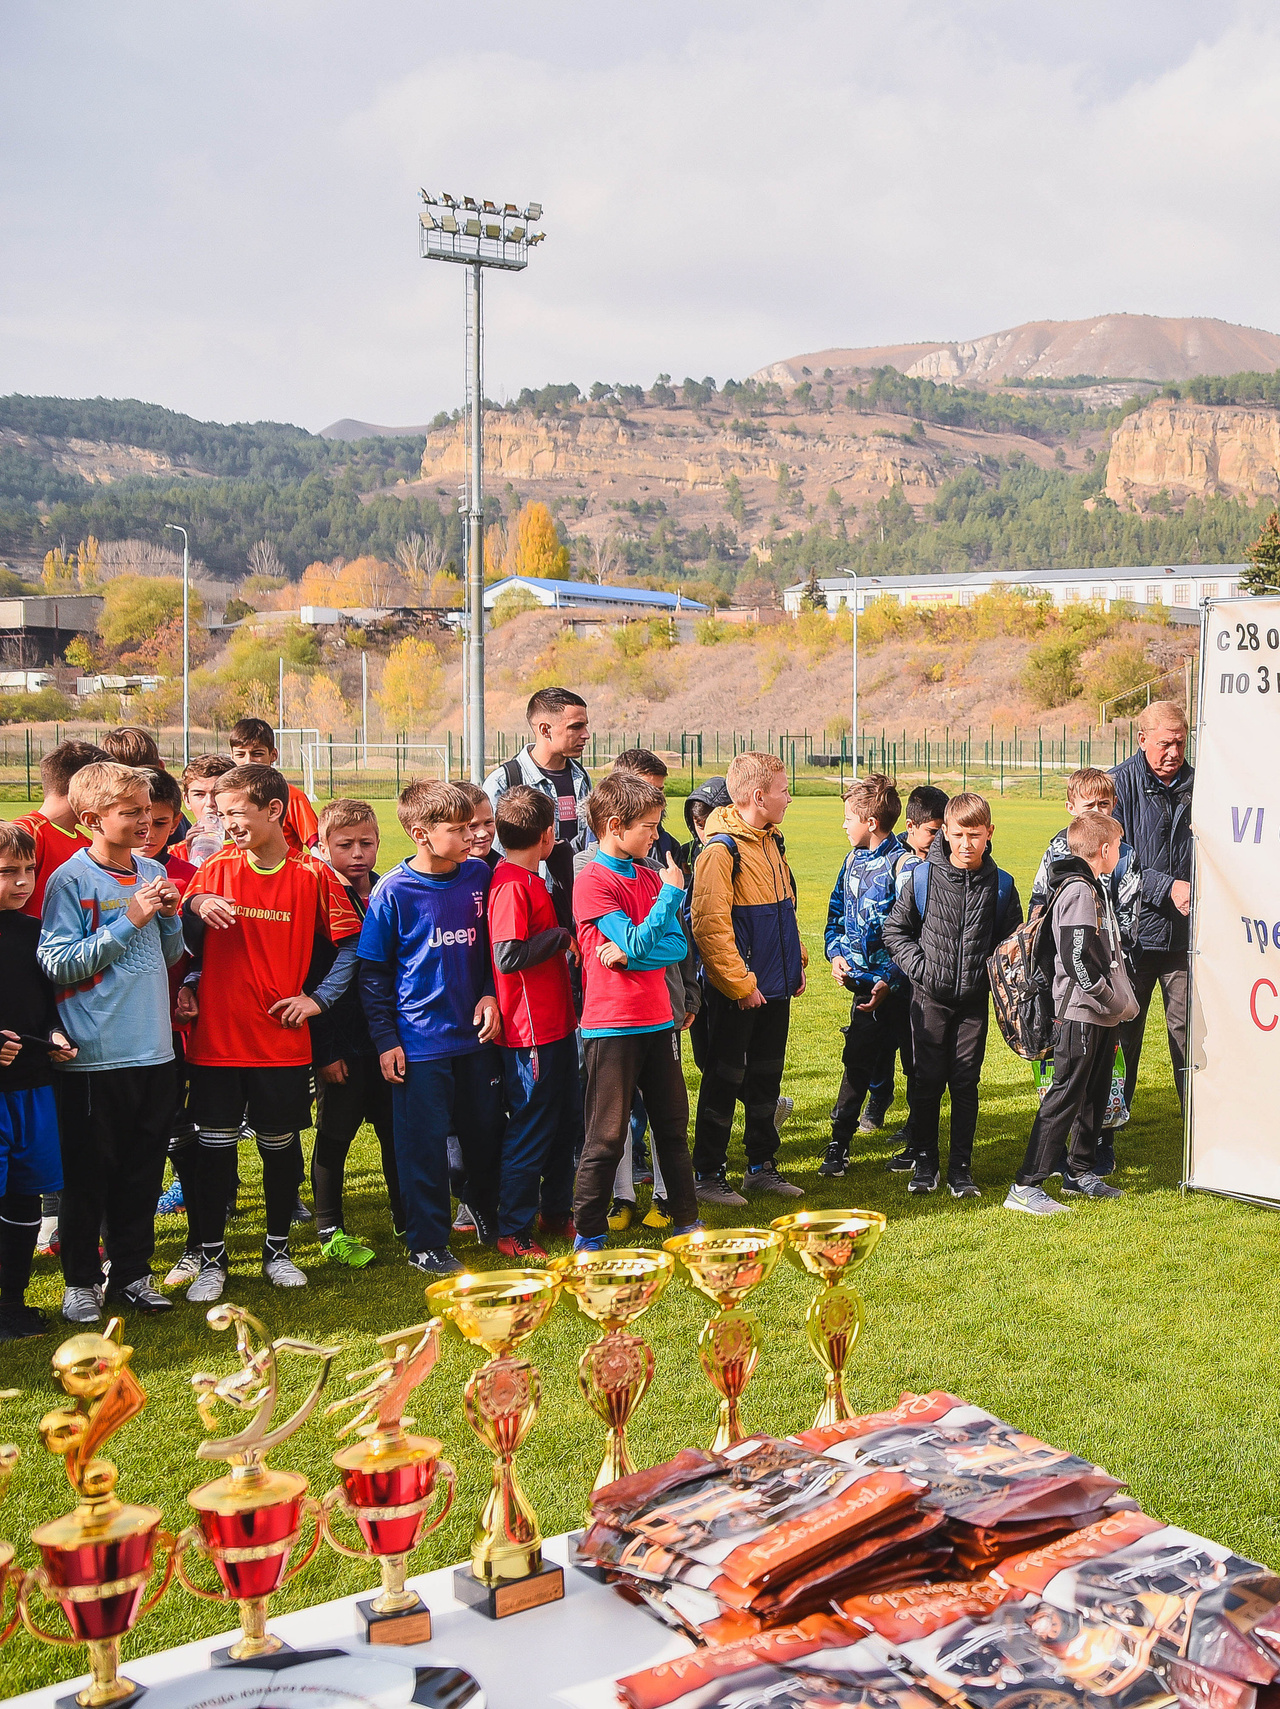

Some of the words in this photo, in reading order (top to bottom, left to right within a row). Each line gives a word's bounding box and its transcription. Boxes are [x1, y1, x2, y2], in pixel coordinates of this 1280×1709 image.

[1216, 628, 1231, 651] с
[1235, 622, 1261, 652] 28
[1219, 669, 1250, 695] по
[1257, 665, 1271, 694] 3
[1230, 805, 1264, 844] VI
[232, 905, 292, 922] ИСЛОВОДСК
[427, 926, 477, 948] Jeep
[1072, 928, 1093, 990] HERITAGE
